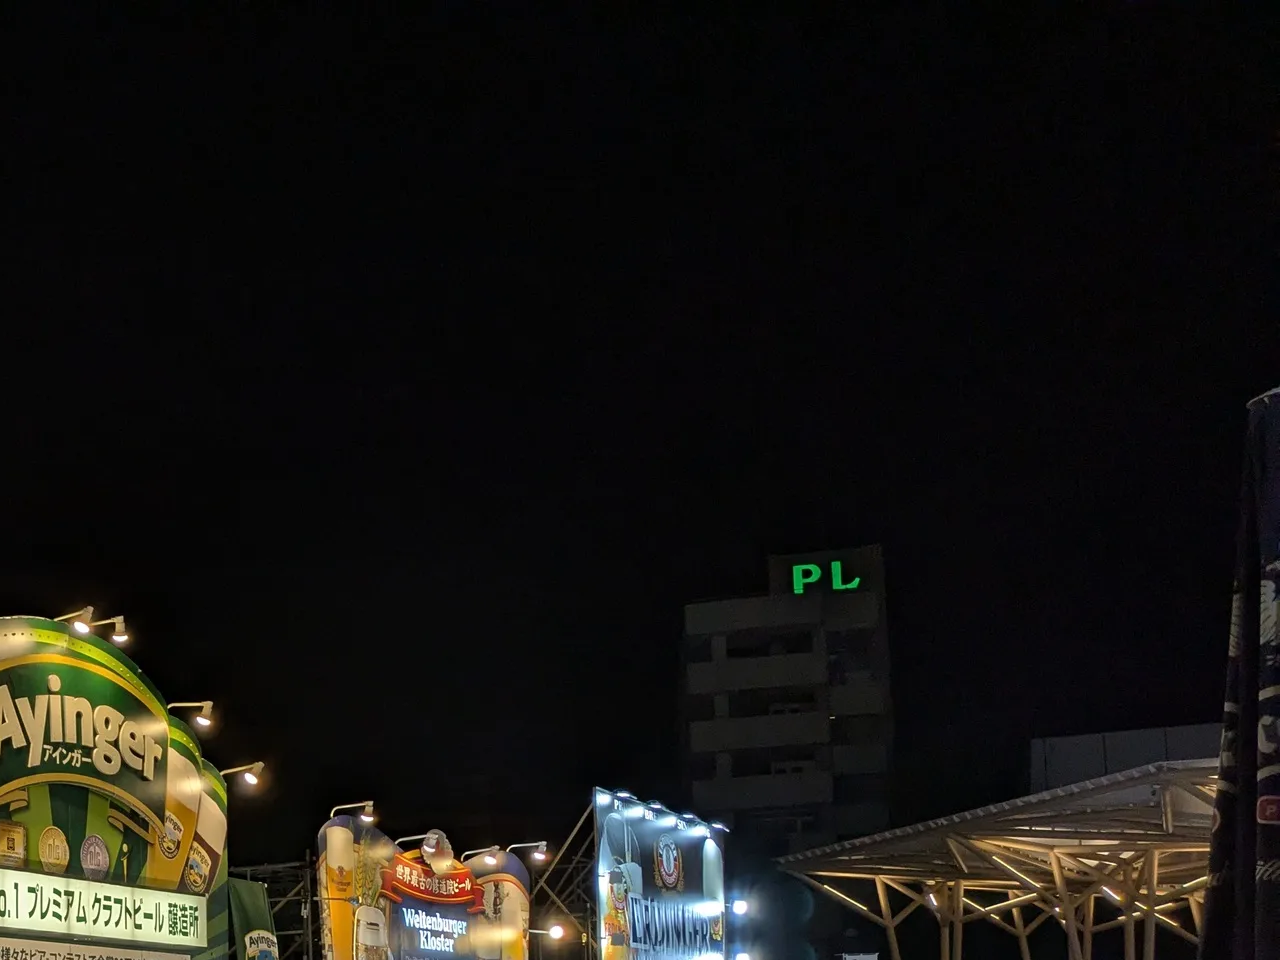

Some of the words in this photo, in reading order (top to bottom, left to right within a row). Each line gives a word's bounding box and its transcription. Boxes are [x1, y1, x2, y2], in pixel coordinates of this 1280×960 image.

[43, 744, 92, 767] アインガー
[165, 814, 183, 834] yinger
[27, 884, 88, 926] プレミアム
[91, 894, 165, 934] クラフトビール
[402, 907, 468, 937] Weltenburger
[248, 933, 277, 949] Ayinger
[419, 930, 455, 953] Kloster
